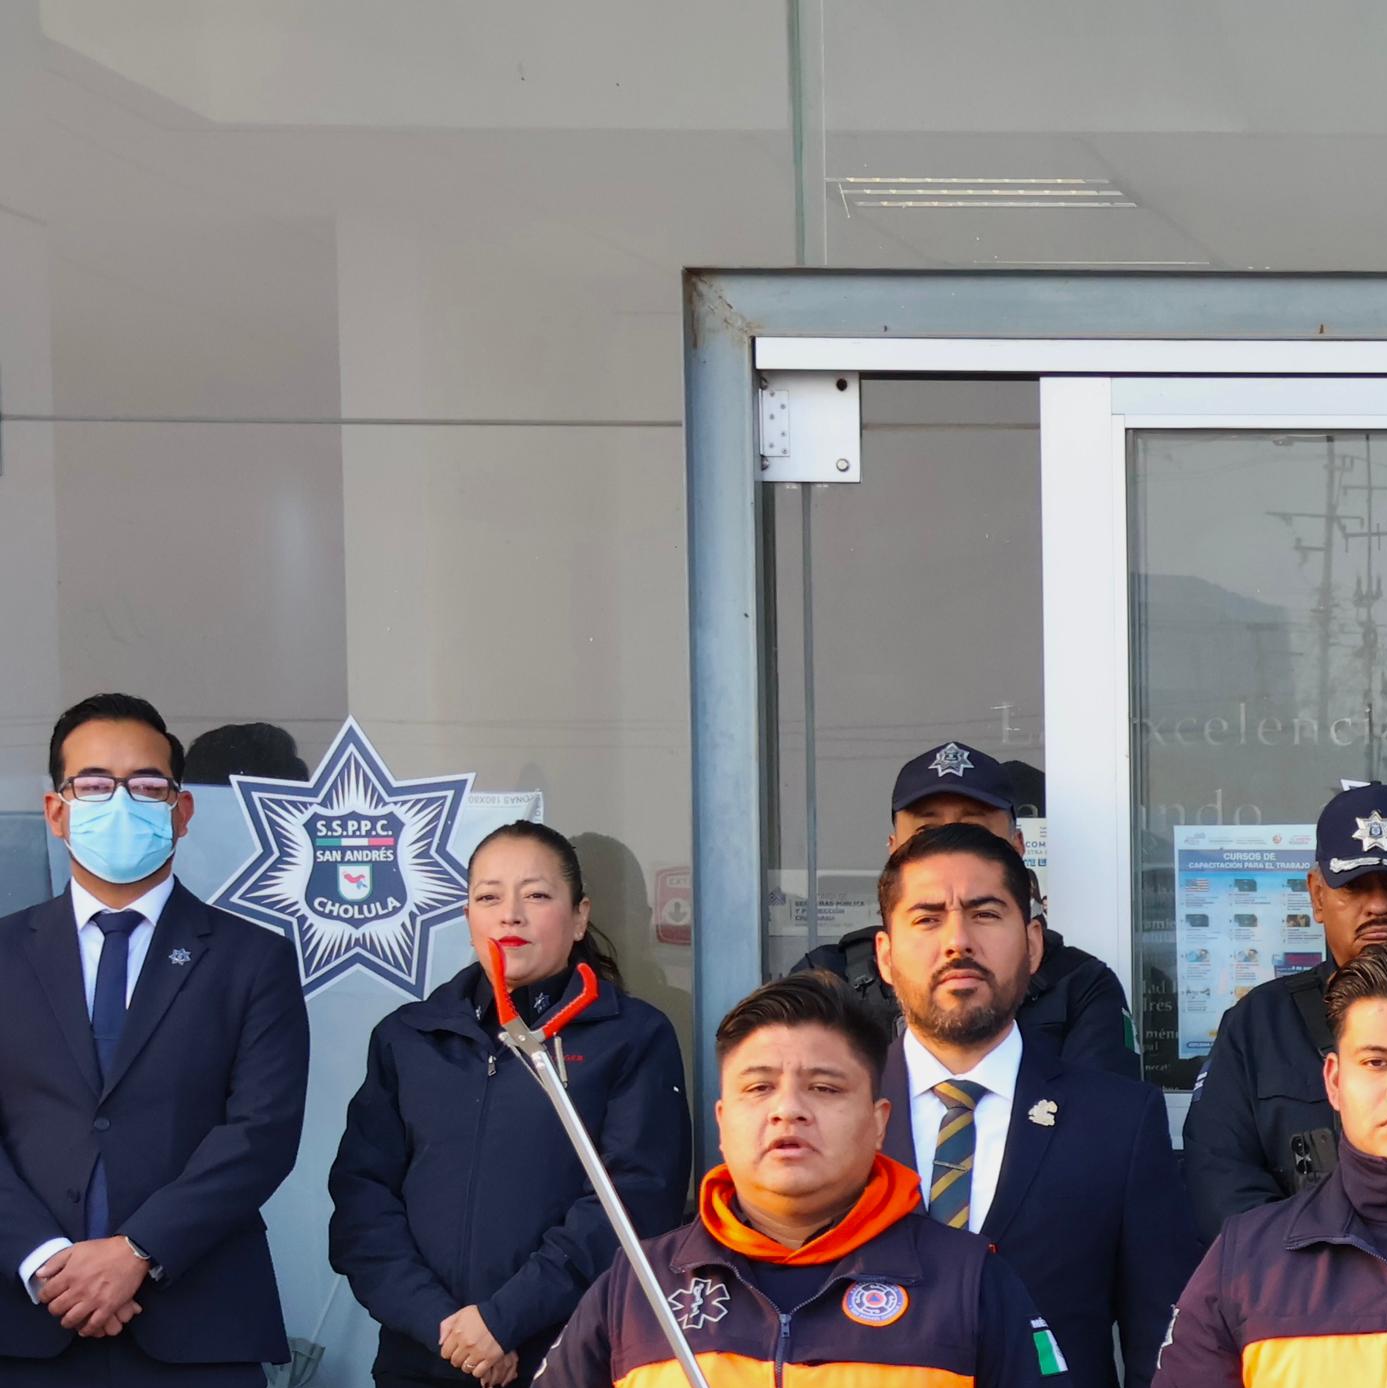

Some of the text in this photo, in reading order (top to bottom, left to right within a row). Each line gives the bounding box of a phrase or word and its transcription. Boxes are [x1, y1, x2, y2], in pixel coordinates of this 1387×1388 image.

[316, 819, 393, 836] S.S.P.P.C.
[316, 846, 394, 862] SAN ANDRÉS
[1223, 852, 1276, 861] CURSOS DE
[1244, 861, 1264, 869] PARA
[1265, 861, 1274, 869] EL
[1276, 861, 1310, 869] TRABAJO
[312, 896, 401, 919] CHOLULA
